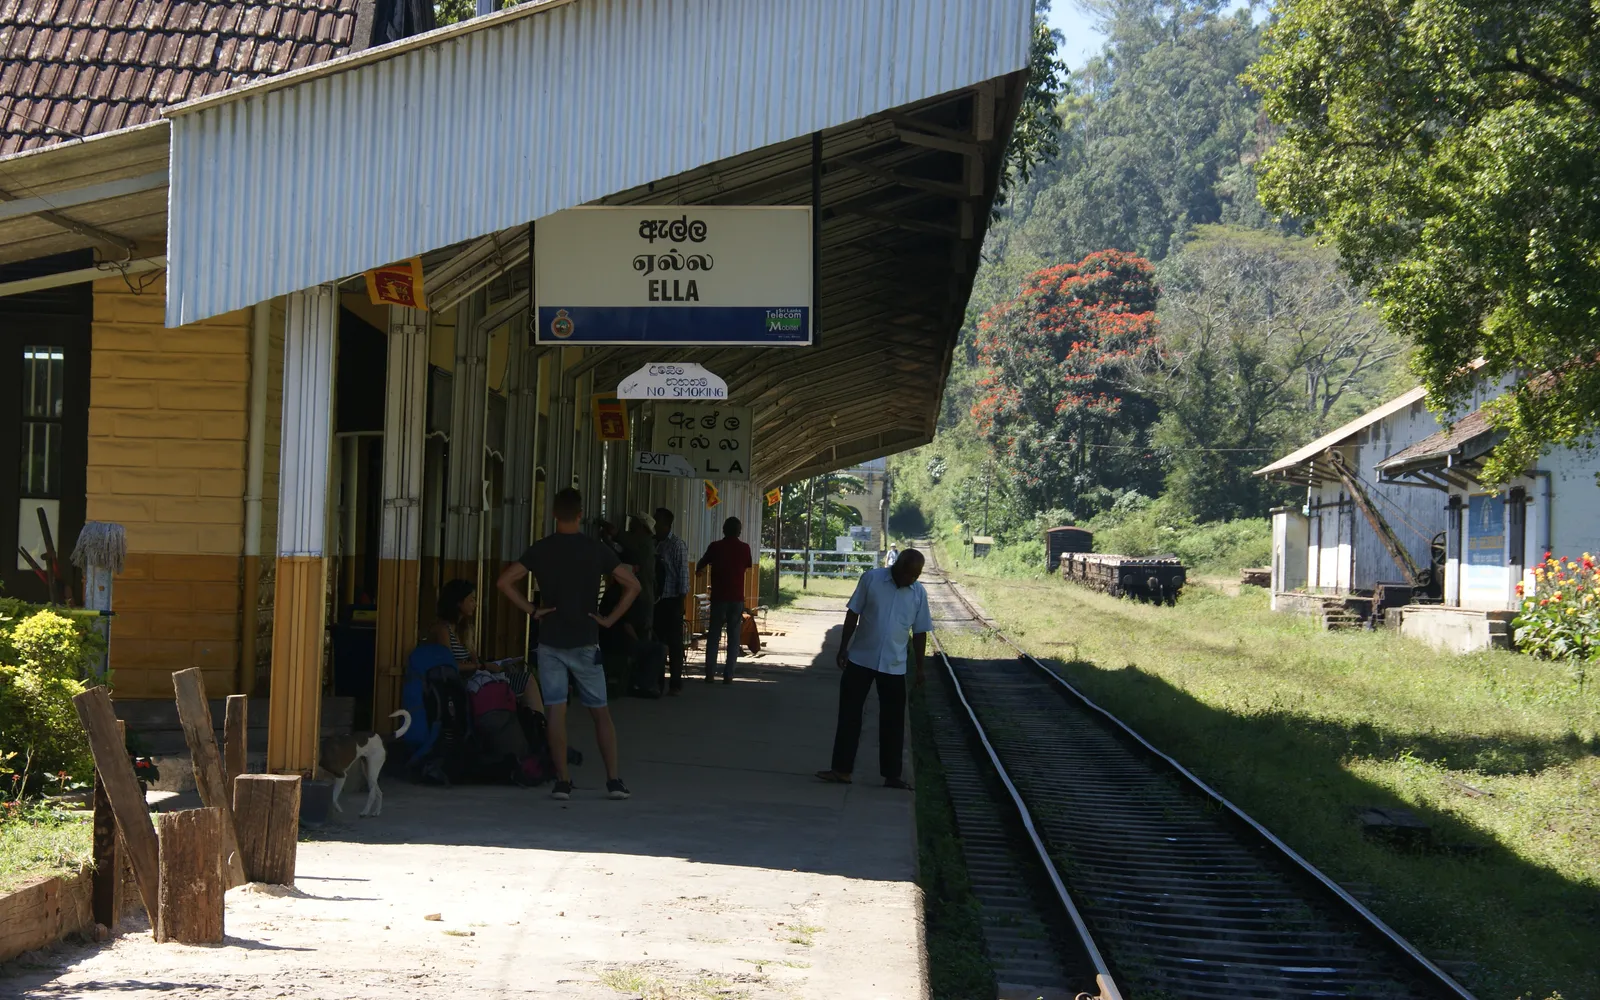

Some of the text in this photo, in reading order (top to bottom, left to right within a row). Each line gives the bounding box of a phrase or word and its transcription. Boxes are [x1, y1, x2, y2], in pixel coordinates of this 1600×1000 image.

[638, 214, 708, 244] ඇල්ල
[632, 248, 714, 276] ஏல்ல
[648, 279, 700, 302] ELLA
[765, 309, 802, 319] Telecom
[768, 321, 799, 332] Mobitel
[646, 386, 724, 397] NO SMOKING
[639, 452, 670, 466] EXIT
[694, 459, 744, 474] LA
